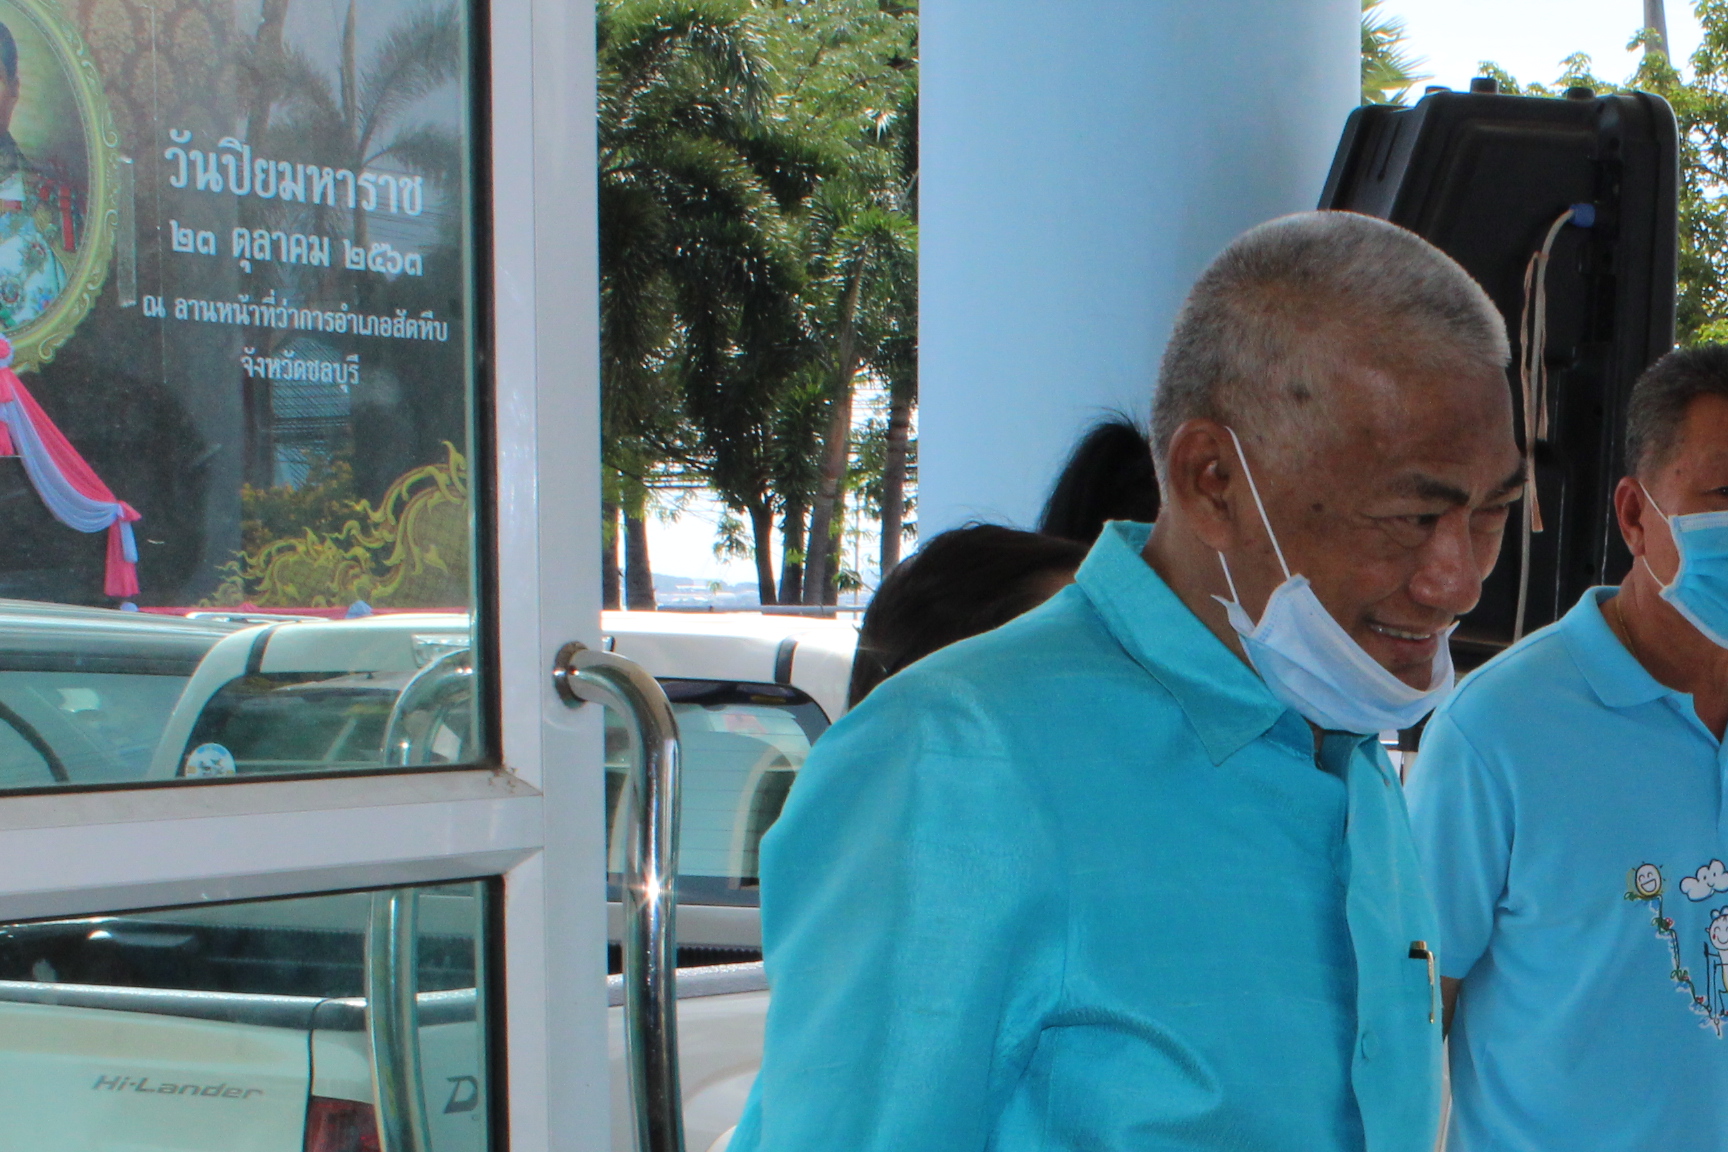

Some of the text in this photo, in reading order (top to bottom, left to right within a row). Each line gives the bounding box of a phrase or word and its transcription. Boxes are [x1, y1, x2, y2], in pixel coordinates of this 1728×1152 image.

[164, 128, 424, 216] วันปิยมหาราช
[169, 218, 424, 278] ๒๓ ตุลาคม ๒๕๖๓
[141, 294, 167, 319] ณ
[239, 345, 361, 394] จังหวัดชลบุรี
[92, 1074, 265, 1100] Hi-Lander
